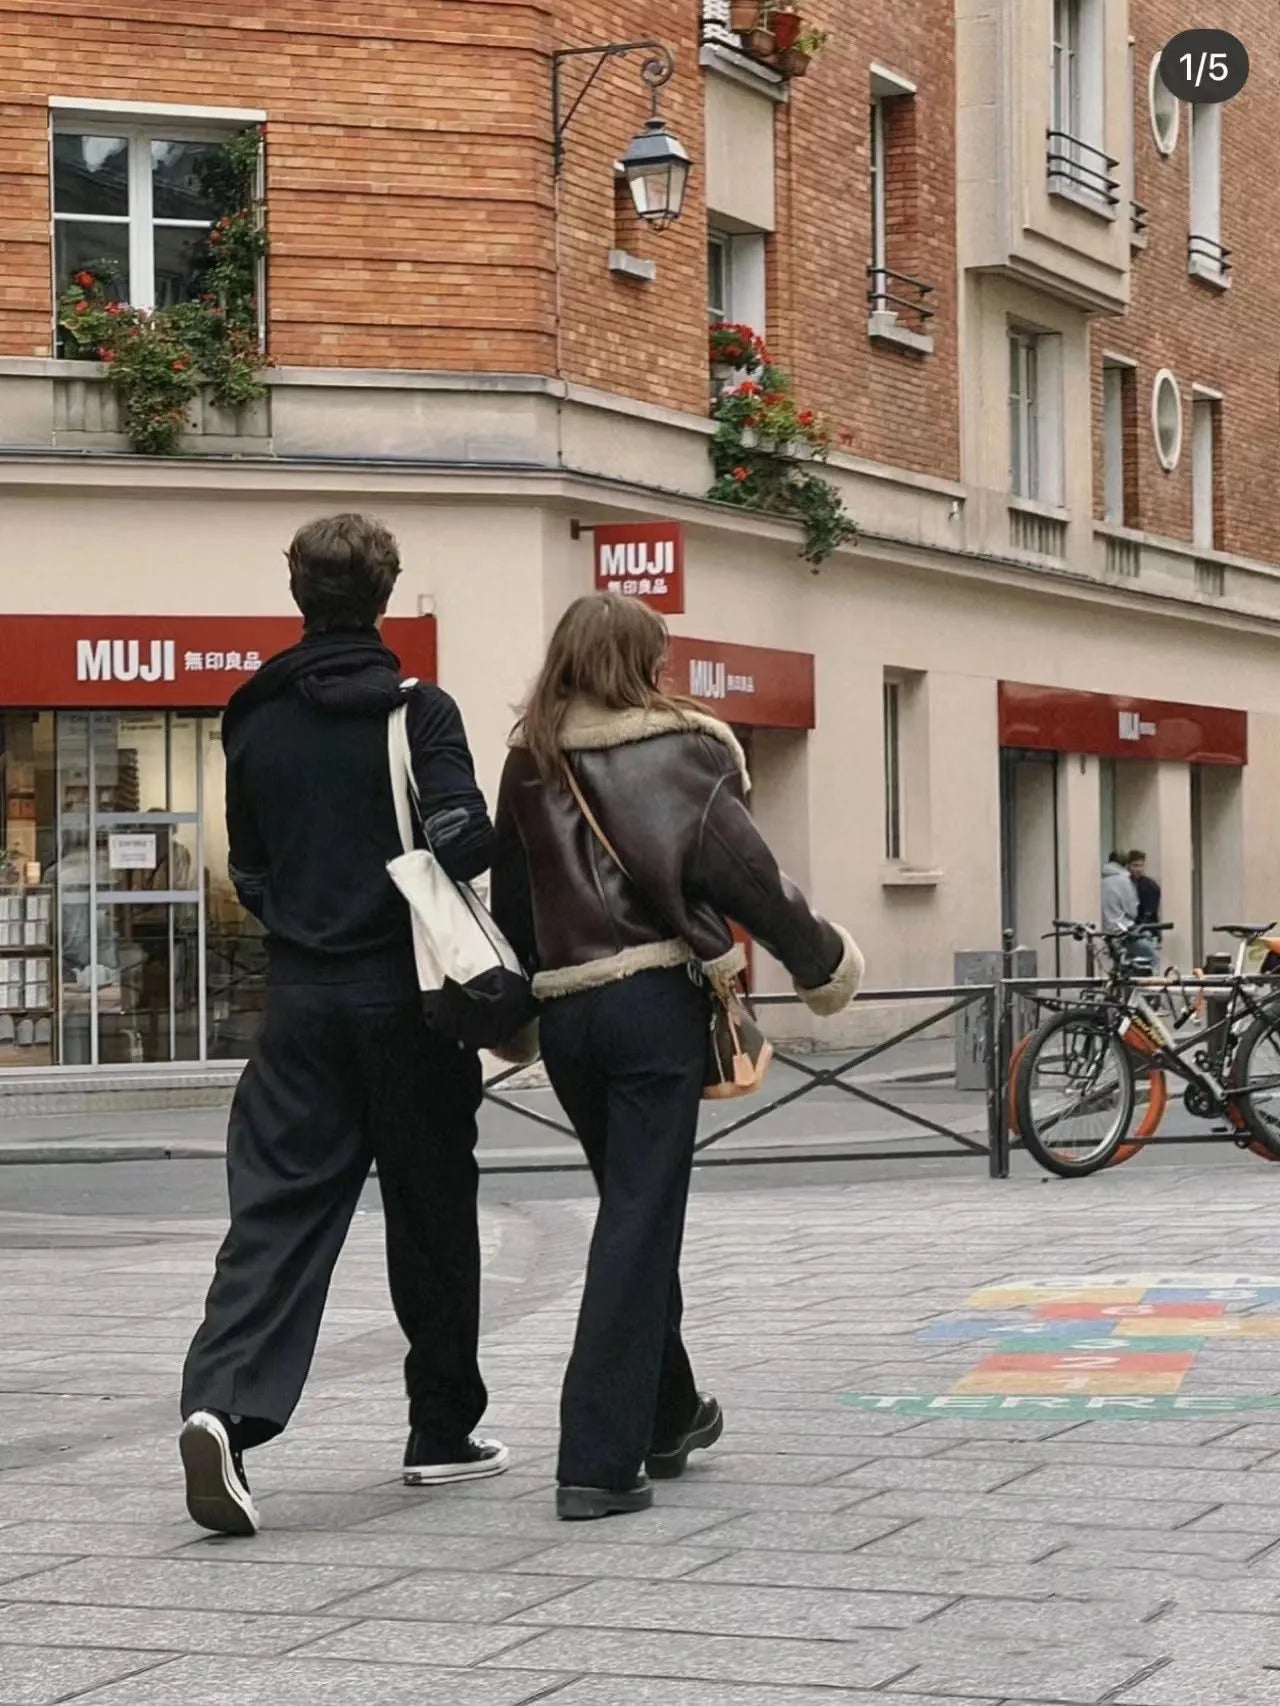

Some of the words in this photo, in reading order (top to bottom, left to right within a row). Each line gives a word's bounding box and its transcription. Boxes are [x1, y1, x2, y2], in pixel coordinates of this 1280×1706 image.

[600, 541, 675, 576] MUJI
[76, 639, 176, 682] MUJI
[184, 651, 263, 672] 無印良品
[689, 659, 726, 699] MUJI
[1052, 1355, 1121, 1369] 2
[857, 1395, 1239, 1409] TERRE
